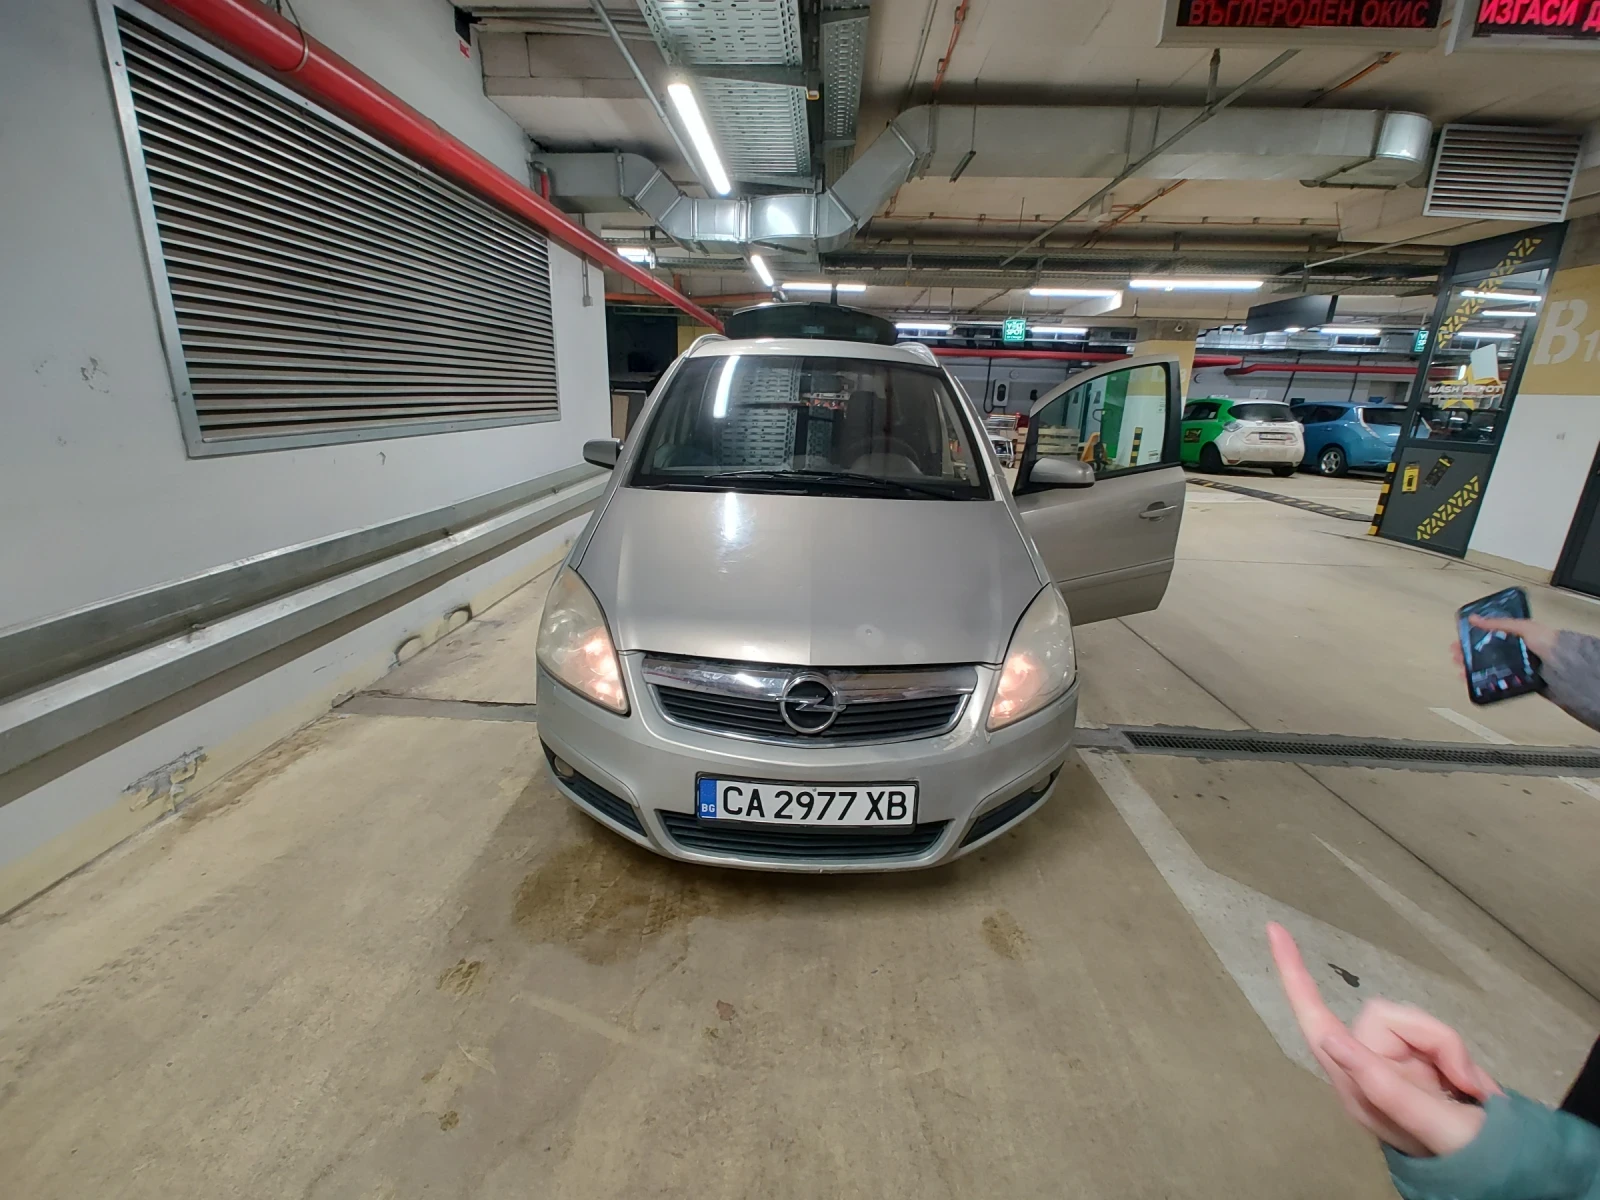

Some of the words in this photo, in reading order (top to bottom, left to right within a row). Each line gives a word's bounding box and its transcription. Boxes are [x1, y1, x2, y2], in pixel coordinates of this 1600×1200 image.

[1188, 0, 1355, 26] ВЪГЛЕРОДЕН
[1361, 0, 1427, 26] ОКИС
[1478, 0, 1580, 26] ИЗГАСИ
[1429, 385, 1460, 394] WASH
[701, 803, 716, 813] BG
[722, 785, 765, 818] CA
[773, 790, 858, 821] 2977
[864, 791, 908, 821] XB
